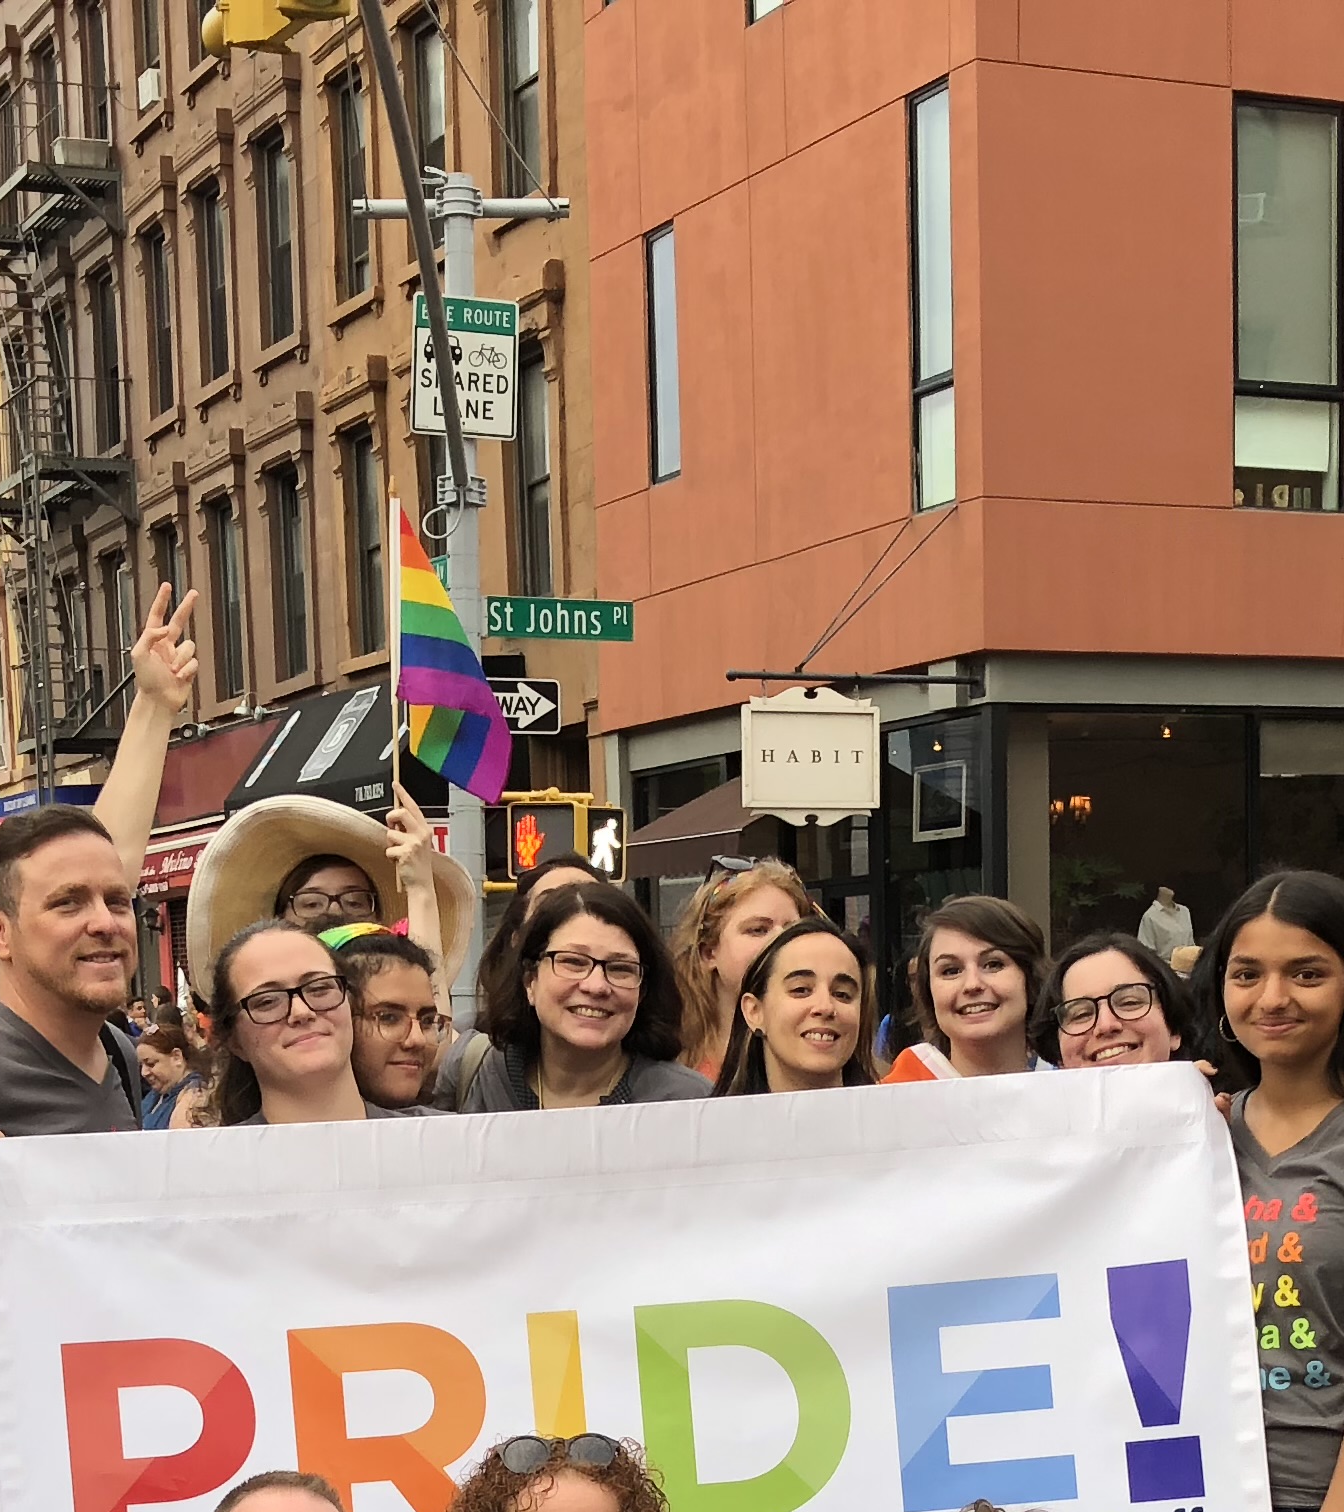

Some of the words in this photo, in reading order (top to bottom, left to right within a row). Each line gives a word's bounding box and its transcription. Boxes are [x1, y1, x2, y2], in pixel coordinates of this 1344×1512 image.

[422, 304, 454, 321] BE
[464, 308, 510, 327] ROUTE
[434, 396, 494, 420] LNE
[490, 602, 513, 632] St
[526, 603, 602, 635] Johns
[613, 606, 627, 625] Pl
[496, 696, 541, 716] WAY
[760, 749, 864, 764] HABIT
[1291, 1192, 1318, 1222] &
[1277, 1231, 1304, 1262] &
[1274, 1274, 1301, 1307] &
[1289, 1317, 1317, 1349] &
[1304, 1360, 1331, 1388] &
